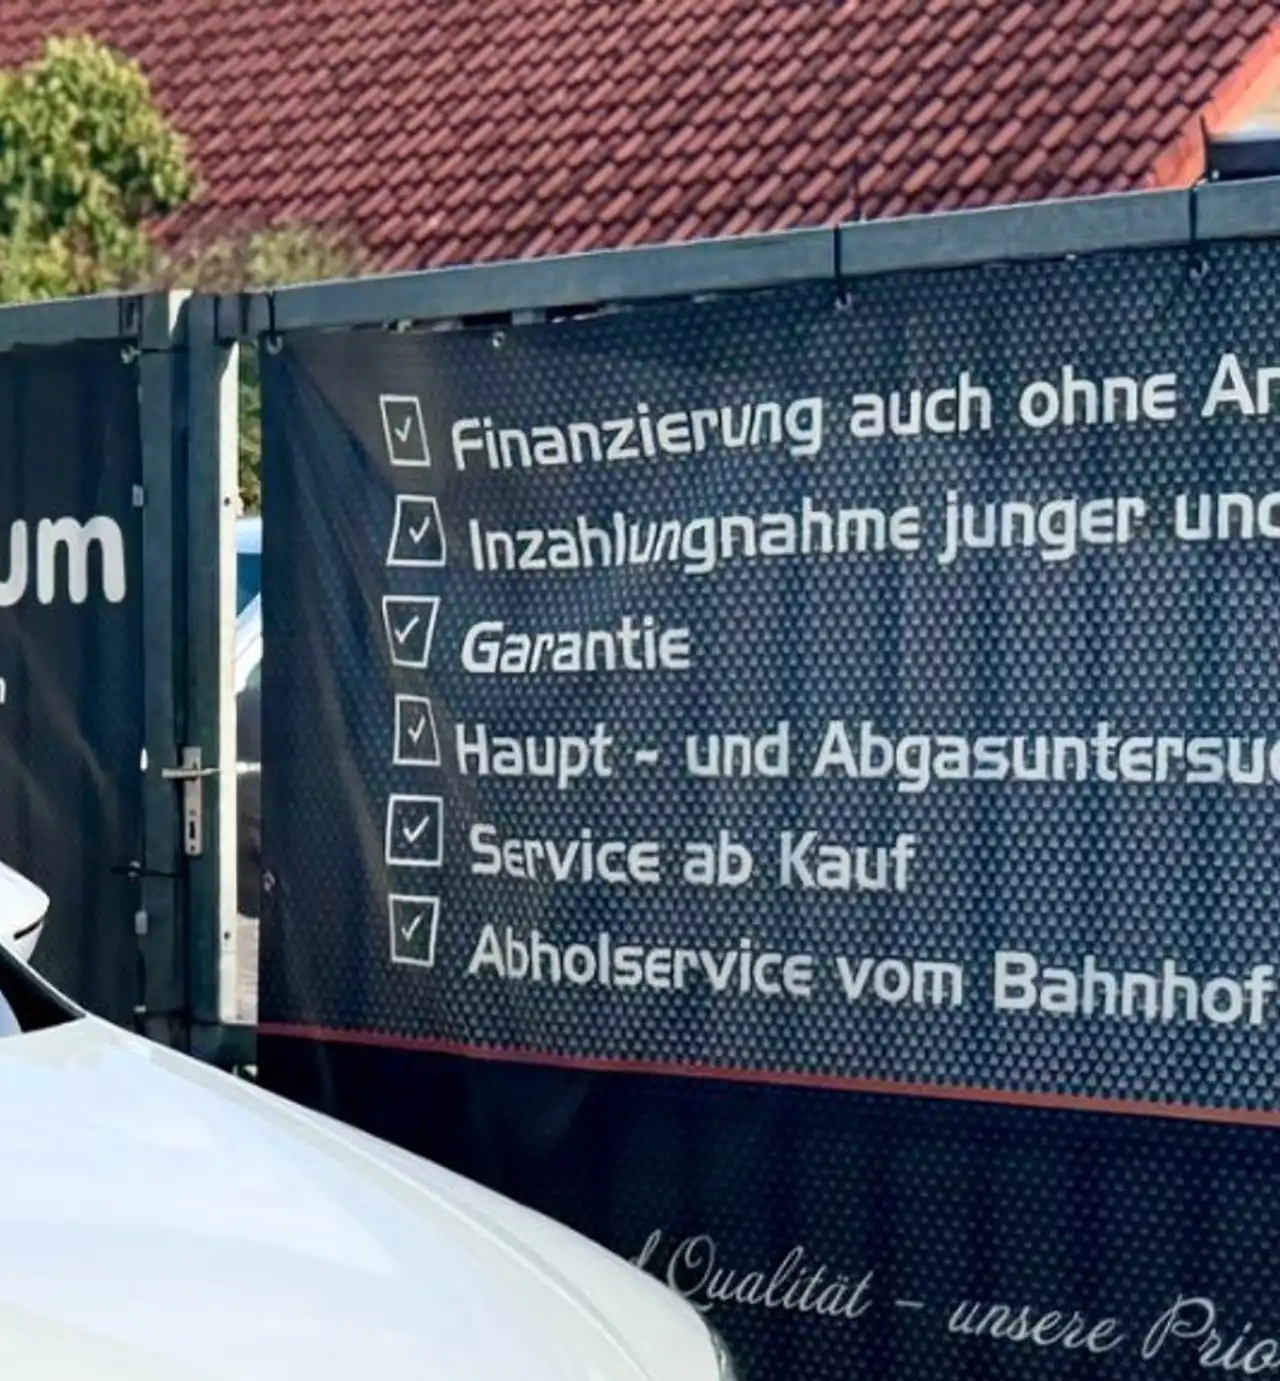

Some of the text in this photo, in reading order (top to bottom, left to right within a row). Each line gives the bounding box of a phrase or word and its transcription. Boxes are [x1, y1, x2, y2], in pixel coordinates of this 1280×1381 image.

[451, 396, 823, 470] Finanzierung
[851, 372, 992, 438] auch
[1018, 364, 1177, 429] ohne
[469, 495, 921, 575] Inzahlungnahme
[937, 493, 1146, 563] junger
[460, 615, 692, 675] Garantie
[454, 722, 613, 789] Haupt
[686, 721, 790, 779] und
[811, 719, 1280, 793] Abgasuntersu
[468, 823, 918, 891] Service ab Kauf
[467, 923, 1278, 1026] Abholservice vom Bahnhof
[665, 1233, 874, 1319] Qualität
[948, 1299, 1126, 1352] unsere
